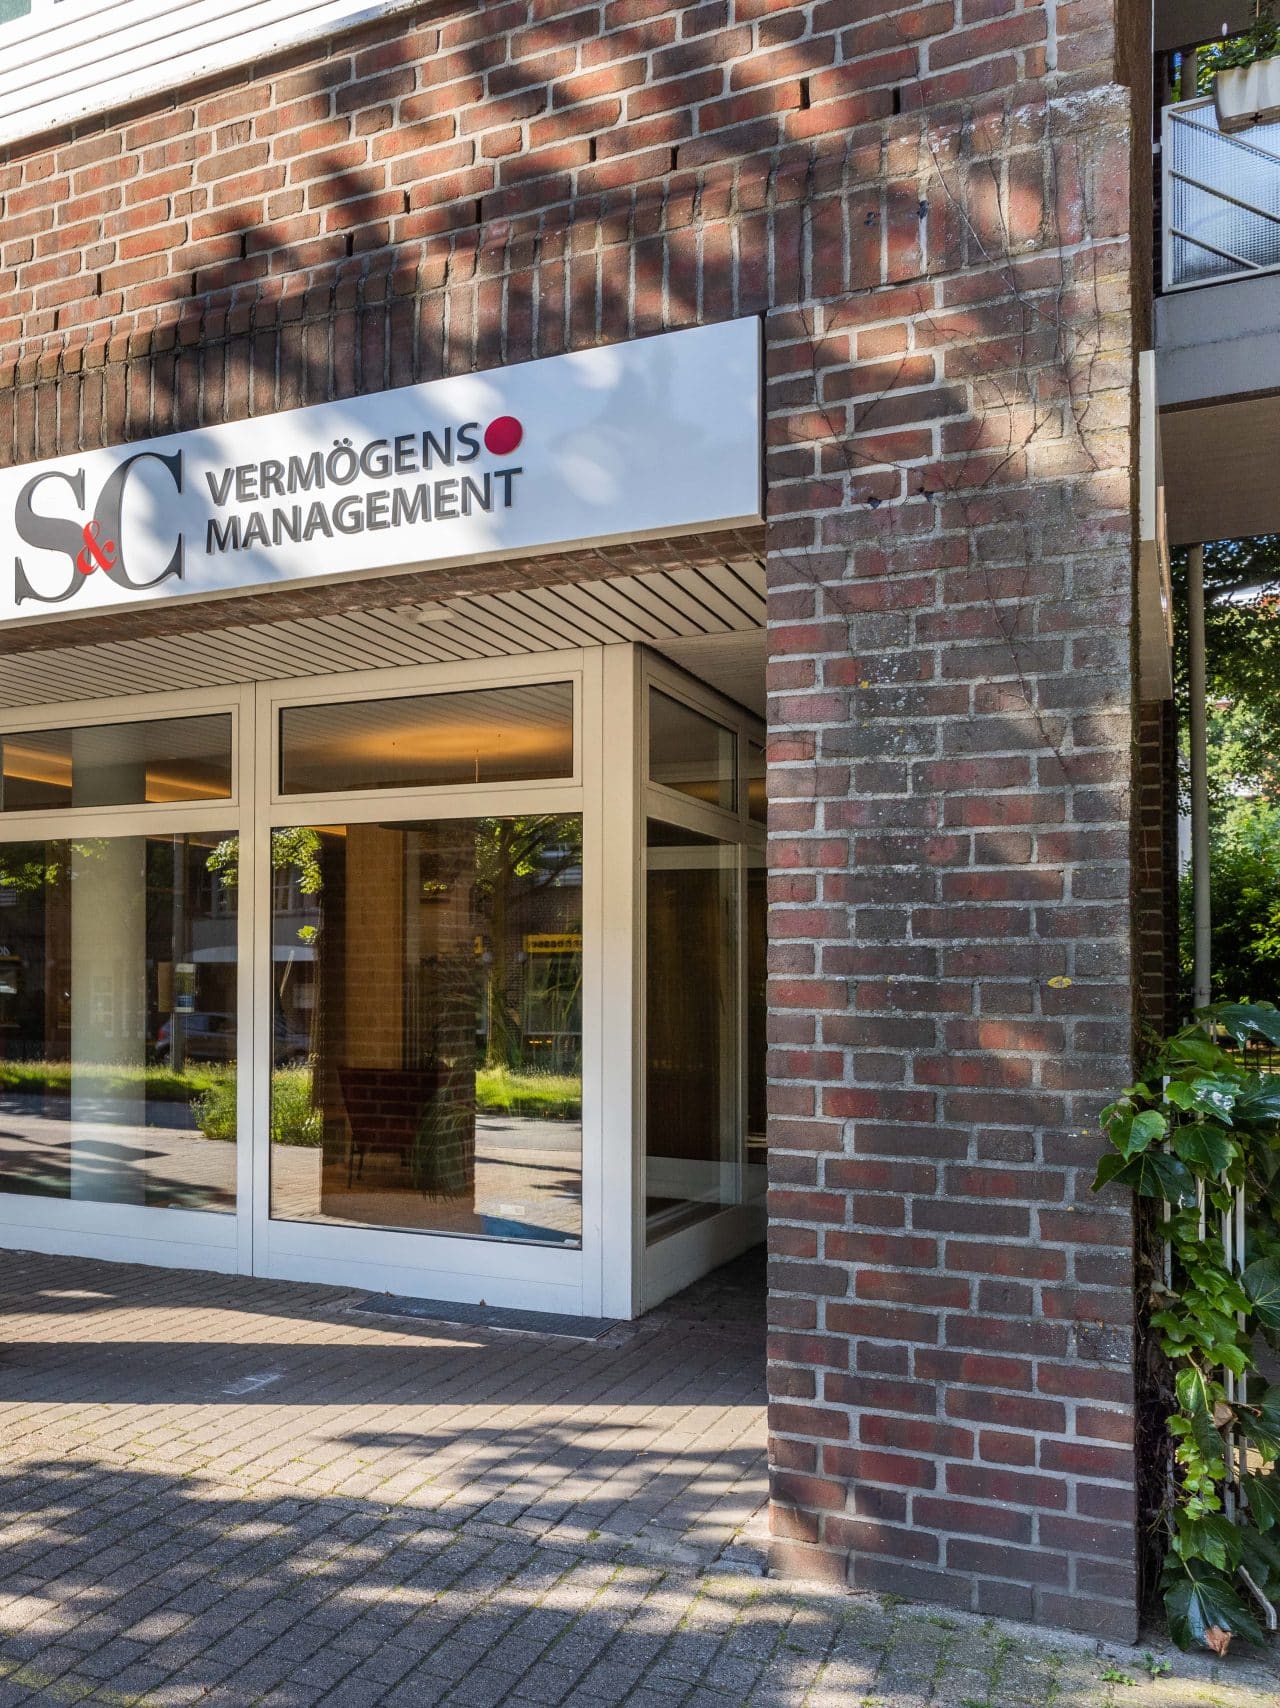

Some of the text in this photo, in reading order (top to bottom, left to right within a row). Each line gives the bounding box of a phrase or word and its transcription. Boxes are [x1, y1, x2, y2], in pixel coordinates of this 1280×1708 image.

[205, 421, 482, 507] VERMÖGENS
[14, 449, 185, 606] S&C
[205, 467, 524, 554] MANAGEMENT
